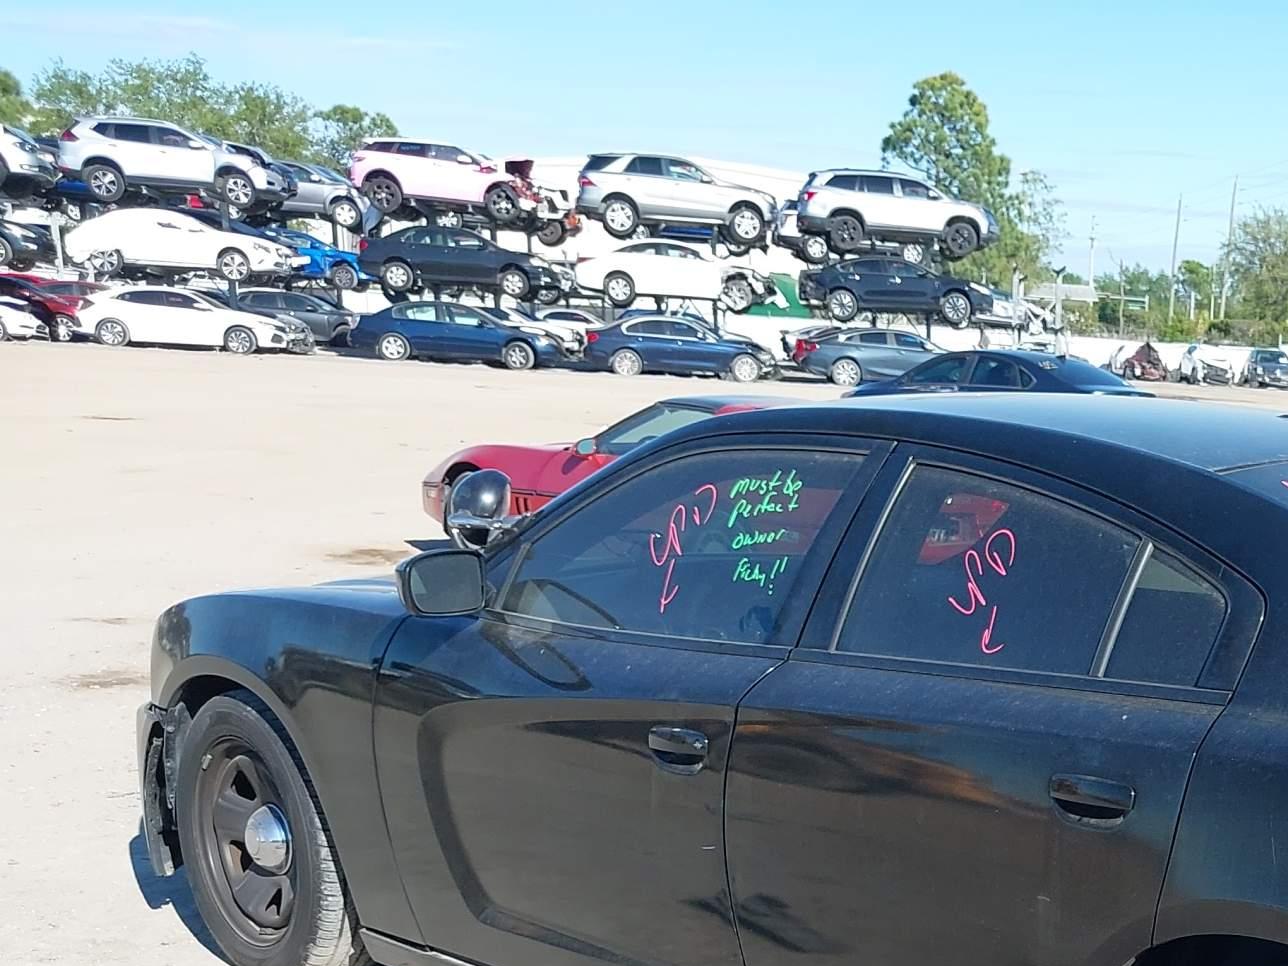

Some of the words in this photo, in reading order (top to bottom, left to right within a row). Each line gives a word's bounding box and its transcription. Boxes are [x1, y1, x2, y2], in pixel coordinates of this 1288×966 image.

[730, 470, 783, 499] must
[783, 469, 803, 497] be
[728, 492, 800, 528] perfect
